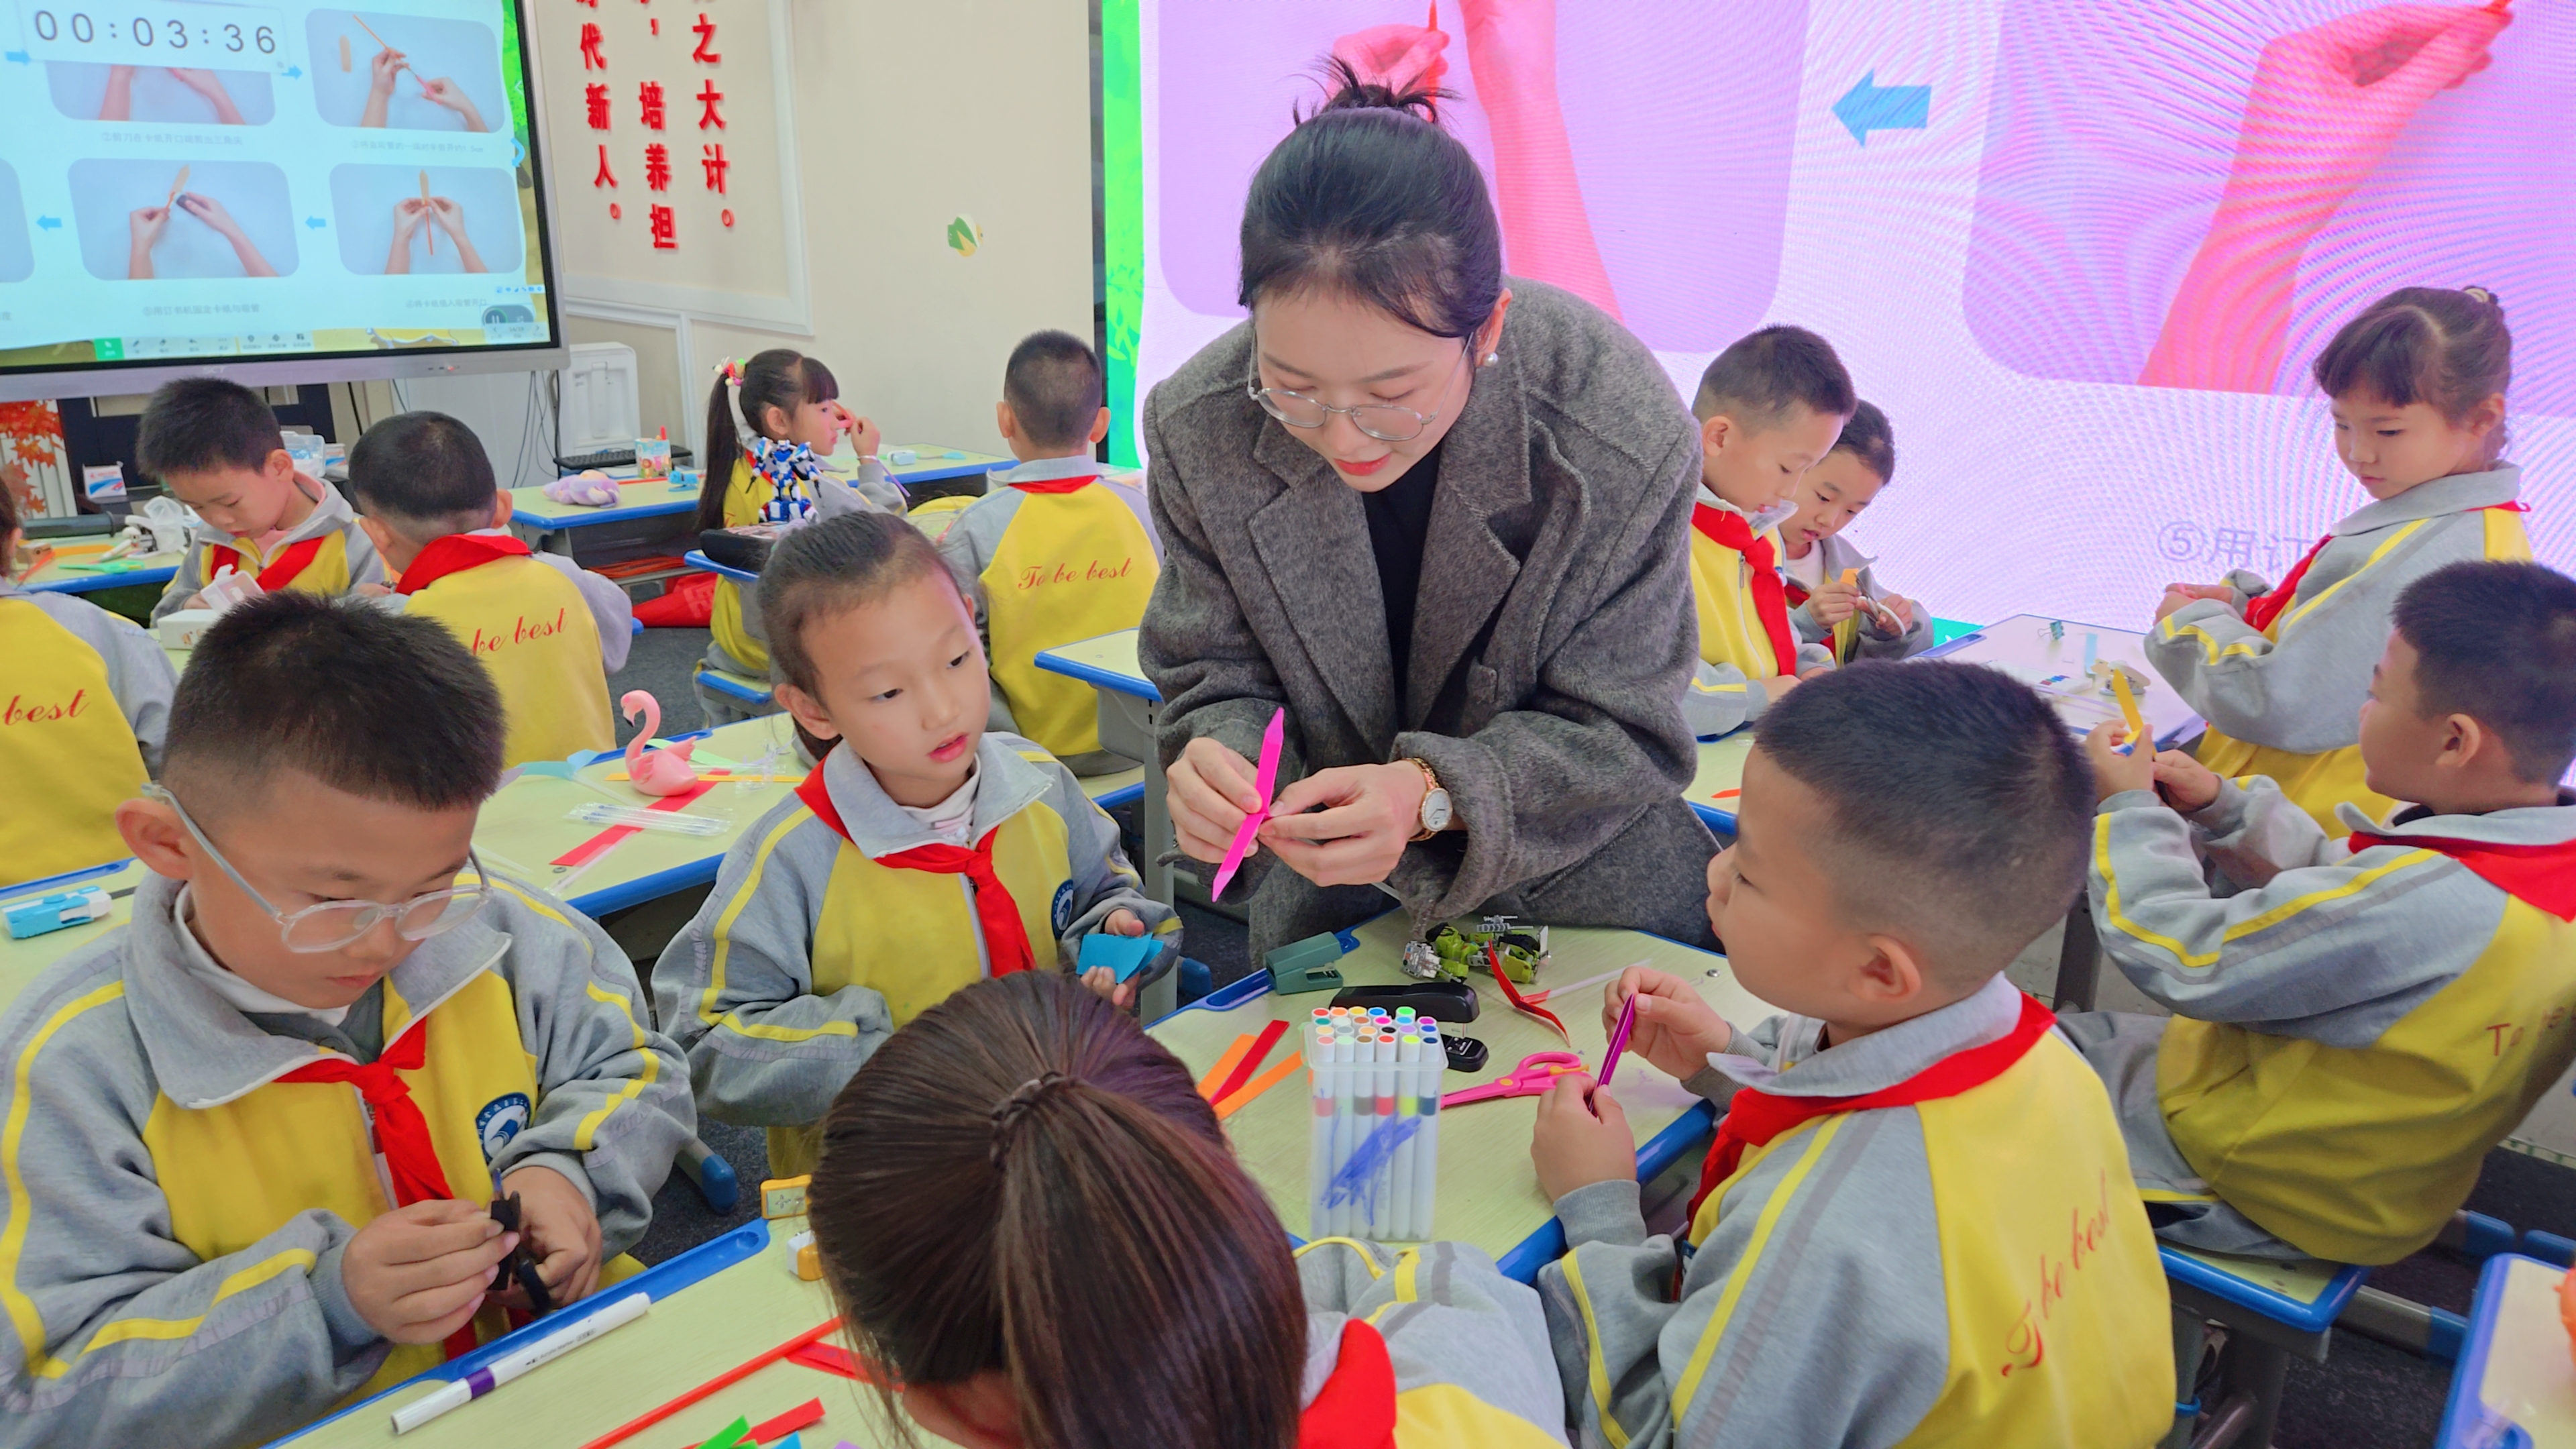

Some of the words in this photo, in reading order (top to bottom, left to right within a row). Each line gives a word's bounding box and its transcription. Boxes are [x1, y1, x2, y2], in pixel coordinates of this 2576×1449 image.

[35, 10, 276, 54] 00:03:36
[577, 0, 621, 219] 代新人。
[639, 0, 679, 249] ，培养担
[692, 13, 735, 227] 之大计。
[1018, 566, 1049, 590] To
[1053, 563, 1081, 584] be
[1086, 557, 1134, 581] best
[472, 627, 508, 656] be
[513, 607, 568, 645] best
[2, 688, 91, 726] best
